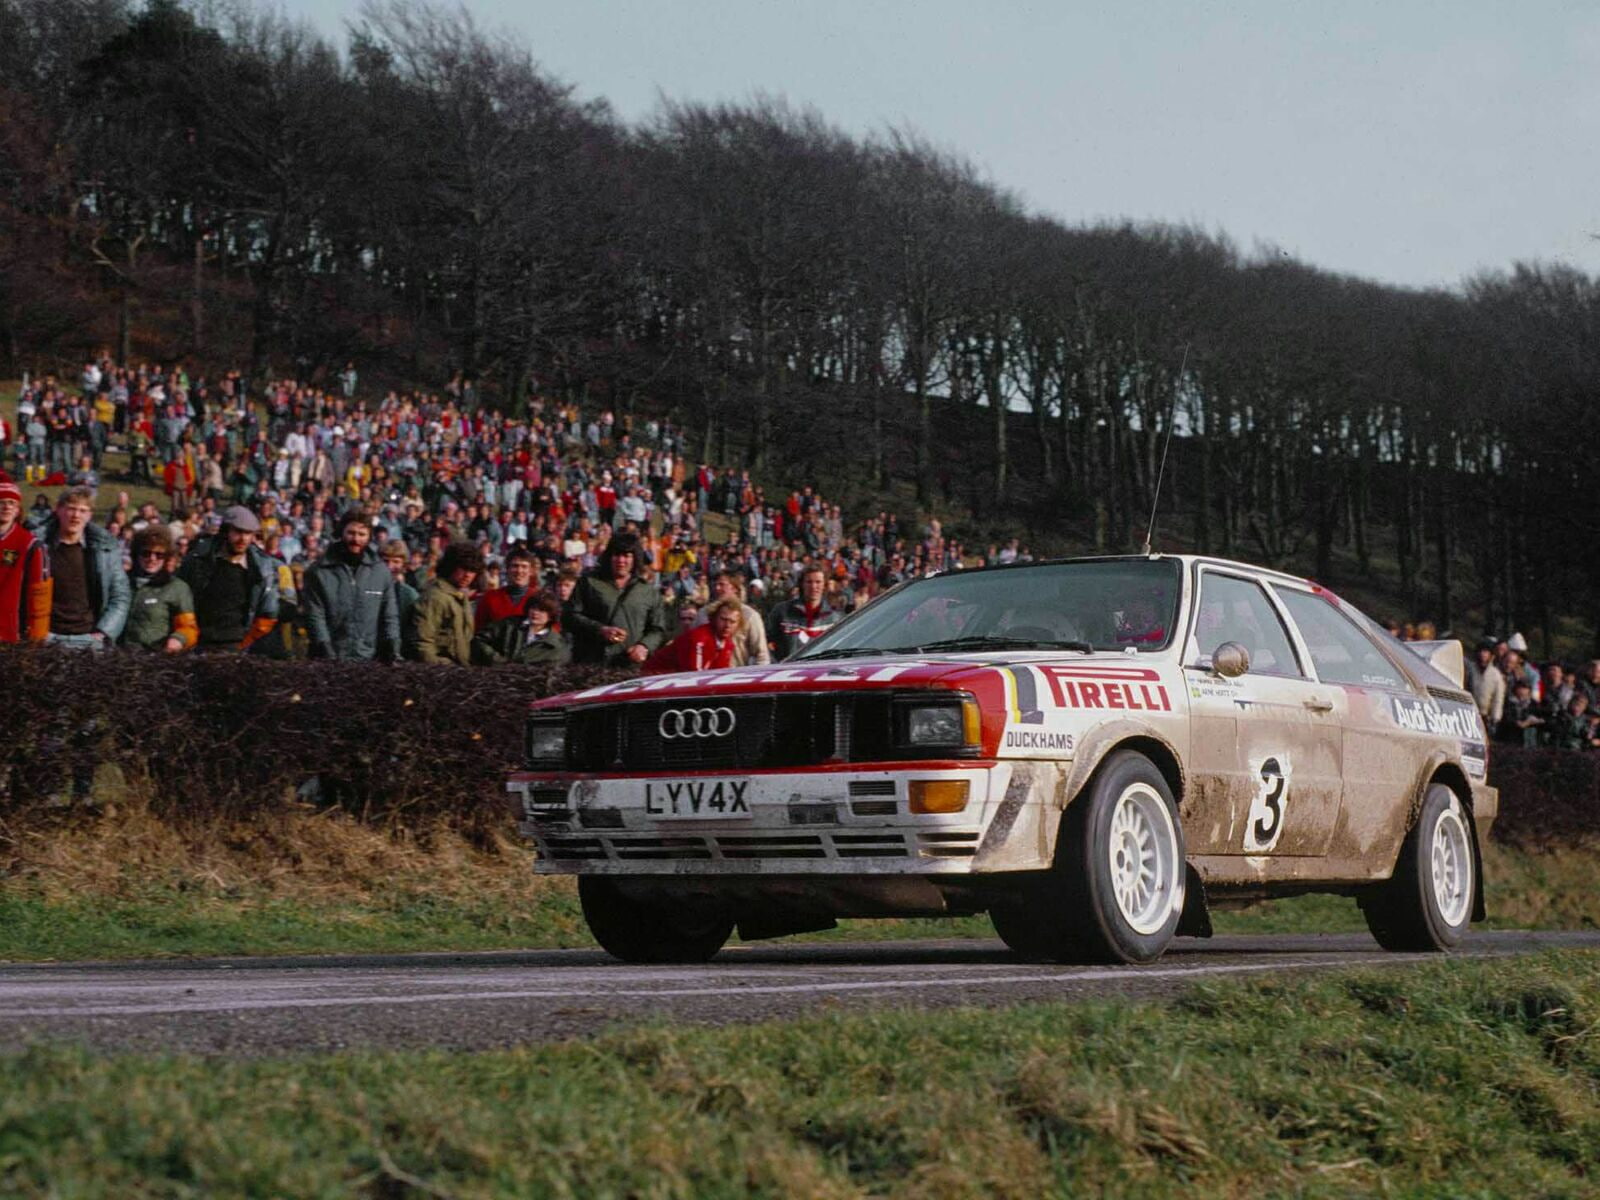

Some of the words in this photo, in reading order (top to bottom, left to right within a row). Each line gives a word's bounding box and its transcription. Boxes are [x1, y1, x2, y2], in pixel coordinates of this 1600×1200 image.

[1036, 665, 1172, 711] PIRELLI
[1394, 698, 1428, 731] Audi
[1423, 701, 1462, 735] Sport
[1458, 708, 1483, 739] UK
[1006, 731, 1074, 750] DUCKHAMS
[645, 780, 749, 815] LYV4X
[1254, 757, 1285, 847] 3
